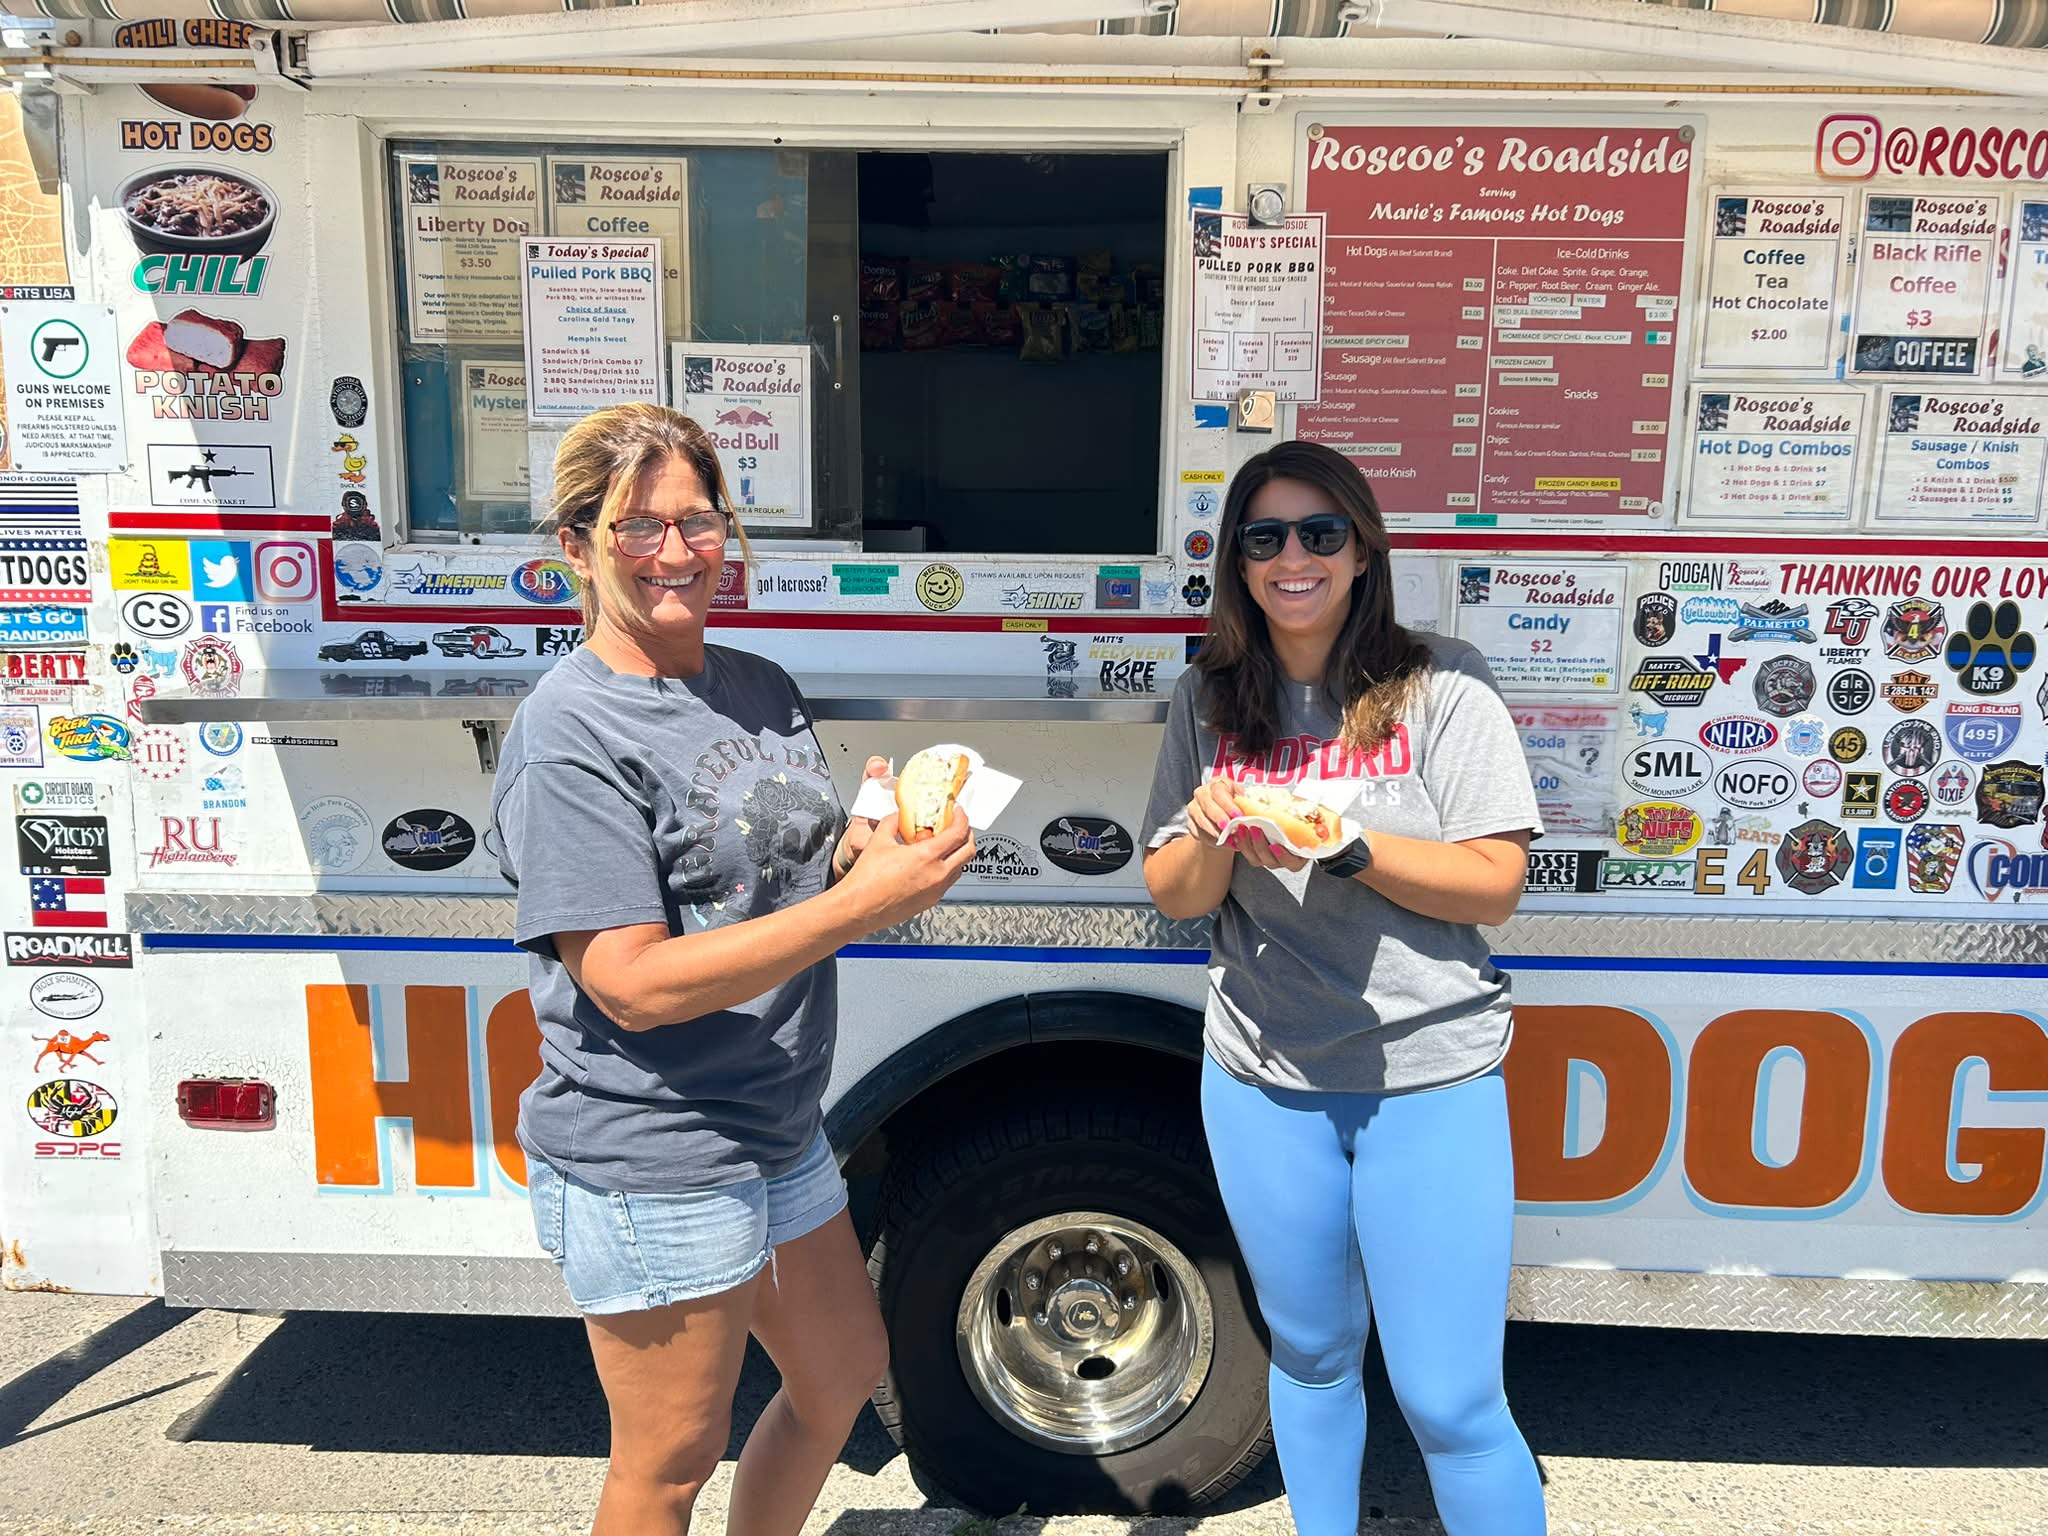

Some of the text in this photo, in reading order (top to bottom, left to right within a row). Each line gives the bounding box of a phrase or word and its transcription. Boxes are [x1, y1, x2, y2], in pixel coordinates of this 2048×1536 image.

[121, 121, 272, 151] HOT DOGS
[1311, 136, 1690, 178] Roscoe's Roadside
[443, 165, 517, 182] Roscoe's
[590, 165, 663, 182] Roscoe's
[454, 186, 536, 202] Roadside
[600, 186, 681, 202] Roadside
[1479, 187, 1517, 199] Serving
[1368, 203, 1625, 227] Marie's Famous Hot Dogs
[1751, 200, 1825, 216] Roscoe's
[1915, 199, 1987, 216] Roscoe's
[417, 217, 530, 237] Liberty Dog
[587, 217, 650, 233] Coffee
[1759, 219, 1840, 235] Roadside
[1915, 219, 1997, 235] Roadside
[1223, 235, 1318, 249] TODAY'S SPECIAL
[547, 246, 649, 258] Today's Special
[1346, 245, 1388, 258] Hot Dogs
[1557, 248, 1629, 259] Ice-Cold Drinks
[1743, 249, 1806, 266] Coffee
[1872, 243, 1982, 263] Black Rifle
[460, 257, 491, 269] $3.50
[1199, 259, 1315, 273] PULLED PORK BBQ
[1521, 267, 1537, 275] Diet
[133, 255, 269, 295] CHILI
[531, 266, 577, 279] Pulled
[582, 267, 615, 279] Pork
[620, 267, 651, 282] BBQ
[1754, 273, 1788, 290] Tea
[1890, 275, 1957, 294] Coffee
[43, 288, 71, 298] USA
[1495, 295, 1513, 304] Iced
[1513, 295, 1527, 304] Tea
[1712, 296, 1829, 311] Hot Chocolate
[1906, 309, 1932, 330] $3
[1750, 328, 1788, 341] $2.00
[1341, 353, 1382, 366] Sausage
[1494, 358, 1522, 366] FROZEN
[1894, 341, 1969, 367] COFFEE
[714, 358, 786, 375] Roscoe's
[135, 371, 282, 396] POTATO
[1324, 372, 1357, 382] Sausage
[17, 384, 111, 394] GUNS WELCOME
[722, 378, 801, 394] Roadside
[1564, 389, 1599, 400] Snacks
[26, 399, 104, 408] ON PREMISES
[152, 396, 269, 420] KNISH
[1322, 401, 1356, 410] Sausage
[1489, 407, 1520, 416] Cookies
[1733, 396, 1813, 415] Roscoe's
[1923, 398, 2004, 416] Roscoe's
[1762, 415, 1851, 433] Roadside
[1953, 417, 2041, 435] Roadside
[708, 432, 779, 450] Red Bull
[1298, 430, 1354, 439] Spicy Sausage
[1699, 440, 1851, 459] Hot Dog Combos
[1911, 440, 2019, 456] Sausage Knish
[738, 456, 757, 471] $3
[1936, 457, 1990, 471] Combos
[1359, 467, 1416, 478] Potato Knish
[519, 570, 571, 590] OBX
[1054, 572, 1085, 580] REQUEST
[1494, 570, 1576, 587] Roscoe's
[1659, 562, 1723, 592] GOOGAN
[1781, 564, 1921, 596] THANKING
[1932, 566, 1991, 597] OUR
[757, 576, 828, 595] got lacrosse?
[1024, 593, 1084, 610] SAINTS
[1526, 588, 1614, 606] Roadside
[1640, 597, 1675, 609] POLICE
[133, 601, 181, 628] CS
[235, 607, 257, 616] Find
[276, 608, 289, 616] on
[1686, 606, 1738, 618] Yellowbird
[236, 619, 313, 633] Facebook
[1508, 613, 1570, 633] Candy
[1743, 619, 1806, 629] PALMETTO
[1092, 636, 1123, 644] MATT'S
[1530, 639, 1553, 654] $2
[1088, 645, 1177, 660] RECOVERY
[1820, 648, 1870, 657] LIBERTY
[1100, 659, 1157, 679] ROPE
[1972, 666, 2005, 681] K9
[1632, 674, 1713, 689] OFF-ROAD
[1972, 682, 2003, 690] UNIT
[1982, 706, 2019, 714] ISLAND
[50, 717, 90, 733] BREW
[57, 731, 96, 749] THRU
[1526, 736, 1566, 748] Soda
[1711, 722, 1767, 748] NHRA
[1965, 730, 1997, 741] 495
[1836, 737, 1858, 752] 45
[1634, 752, 1702, 778] SML
[1630, 779, 1704, 796] SMITH MOUNTAIN LAKE
[1722, 773, 1789, 795] NOFO
[1938, 789, 1965, 801] DIXIE
[204, 800, 246, 809] BRANDON
[160, 816, 221, 851] RU
[1642, 820, 1694, 839] NUTS
[1736, 829, 1781, 845] RATS
[961, 864, 1039, 876] DUDE SQUAD
[1603, 862, 1692, 875] DIRTY
[1694, 848, 1770, 895] E 4
